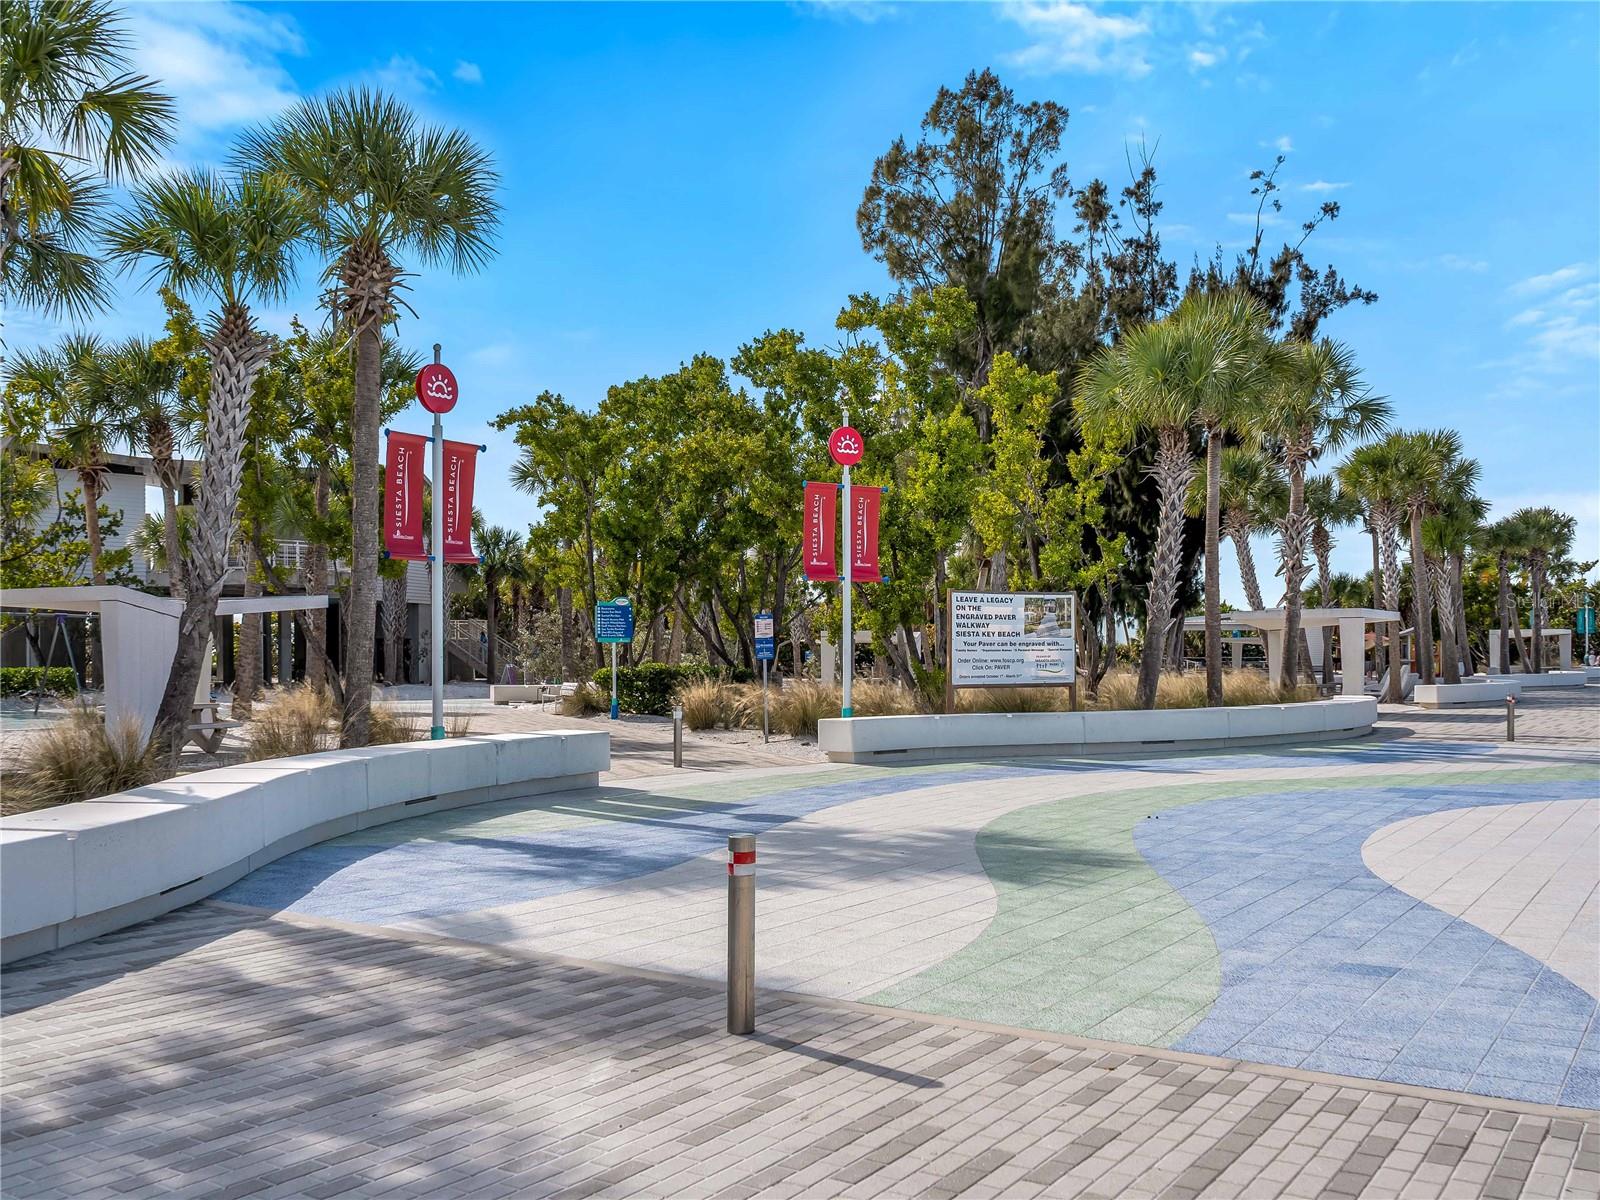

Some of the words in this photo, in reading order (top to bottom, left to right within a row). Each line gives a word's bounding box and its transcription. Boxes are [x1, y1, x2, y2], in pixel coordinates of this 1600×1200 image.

[396, 447, 405, 484] BEACH
[448, 456, 457, 491] BEACH
[395, 490, 403, 527] SIESTA
